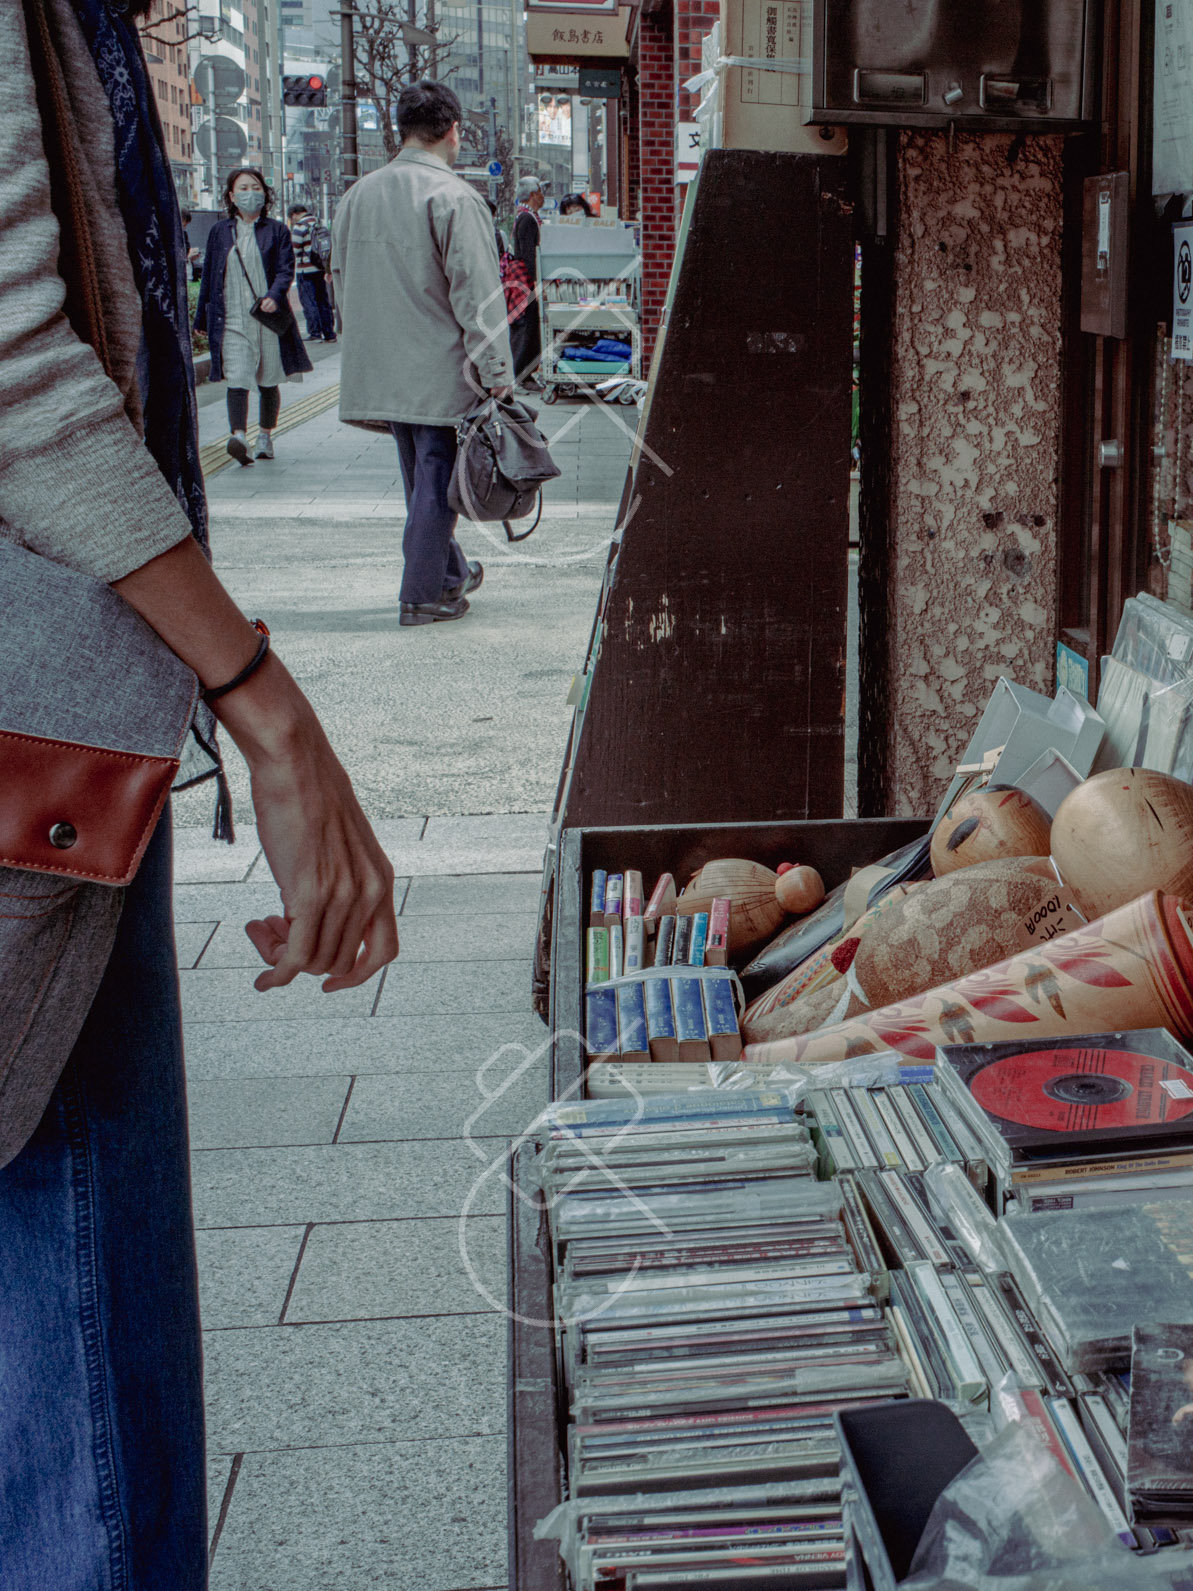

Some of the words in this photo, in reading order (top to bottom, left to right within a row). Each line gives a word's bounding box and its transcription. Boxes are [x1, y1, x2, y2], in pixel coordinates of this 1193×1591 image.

[552, 28, 605, 44] 飯島書店
[1065, 1167, 1088, 1175] ROBERT
[1089, 1165, 1116, 1173] JOHNSON
